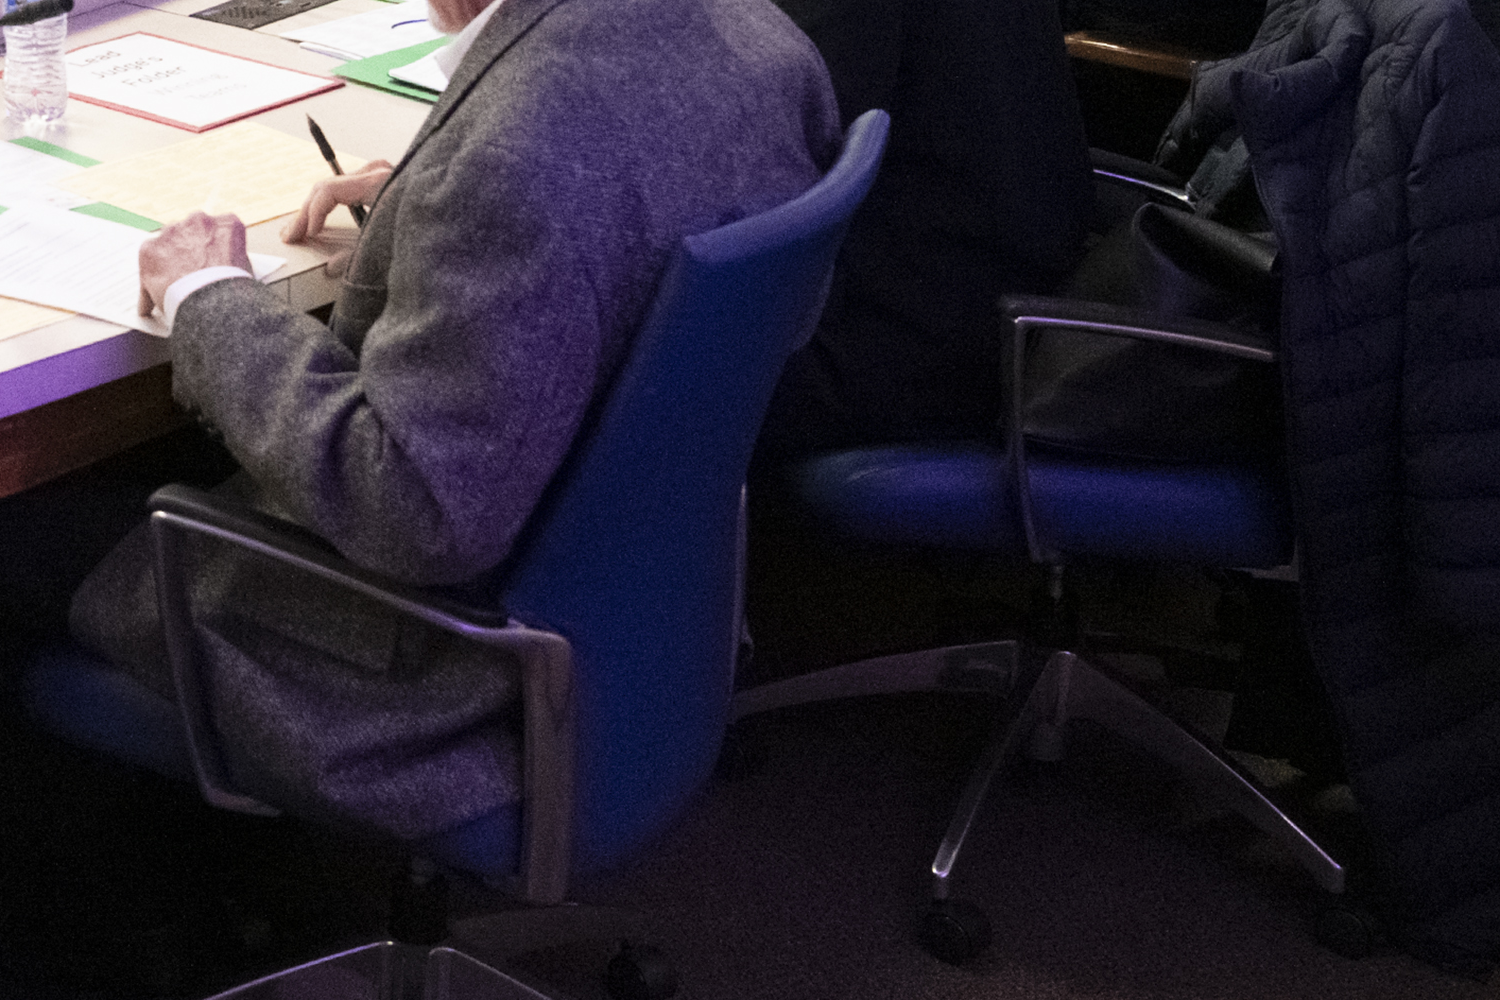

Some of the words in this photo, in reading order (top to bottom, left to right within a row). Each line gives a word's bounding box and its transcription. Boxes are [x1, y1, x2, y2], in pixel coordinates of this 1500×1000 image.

[67, 50, 121, 68] Lead
[91, 56, 164, 80] Judge's
[121, 65, 187, 88] Folder
